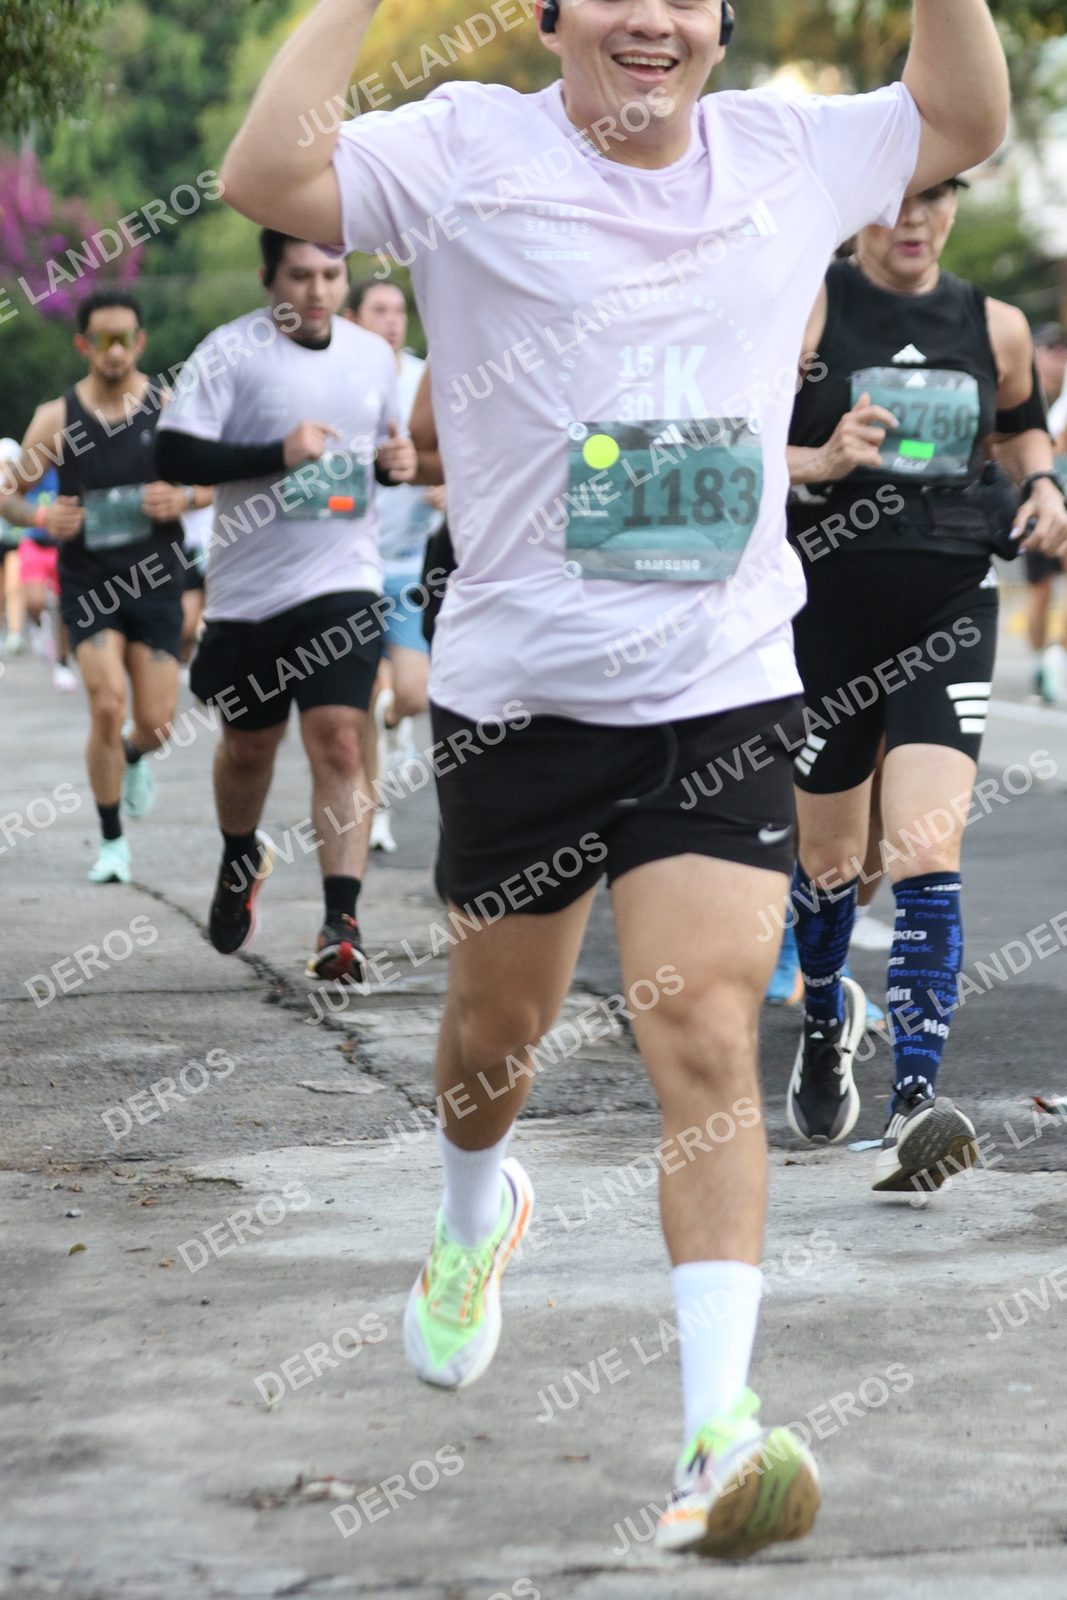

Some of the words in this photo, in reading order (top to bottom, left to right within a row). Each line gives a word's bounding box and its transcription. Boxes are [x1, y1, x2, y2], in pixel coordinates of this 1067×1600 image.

[618, 345, 655, 378] 15
[663, 345, 708, 418] K
[617, 393, 655, 420] 30
[623, 466, 758, 527] 1183
[634, 559, 701, 570] SAMSUNG
